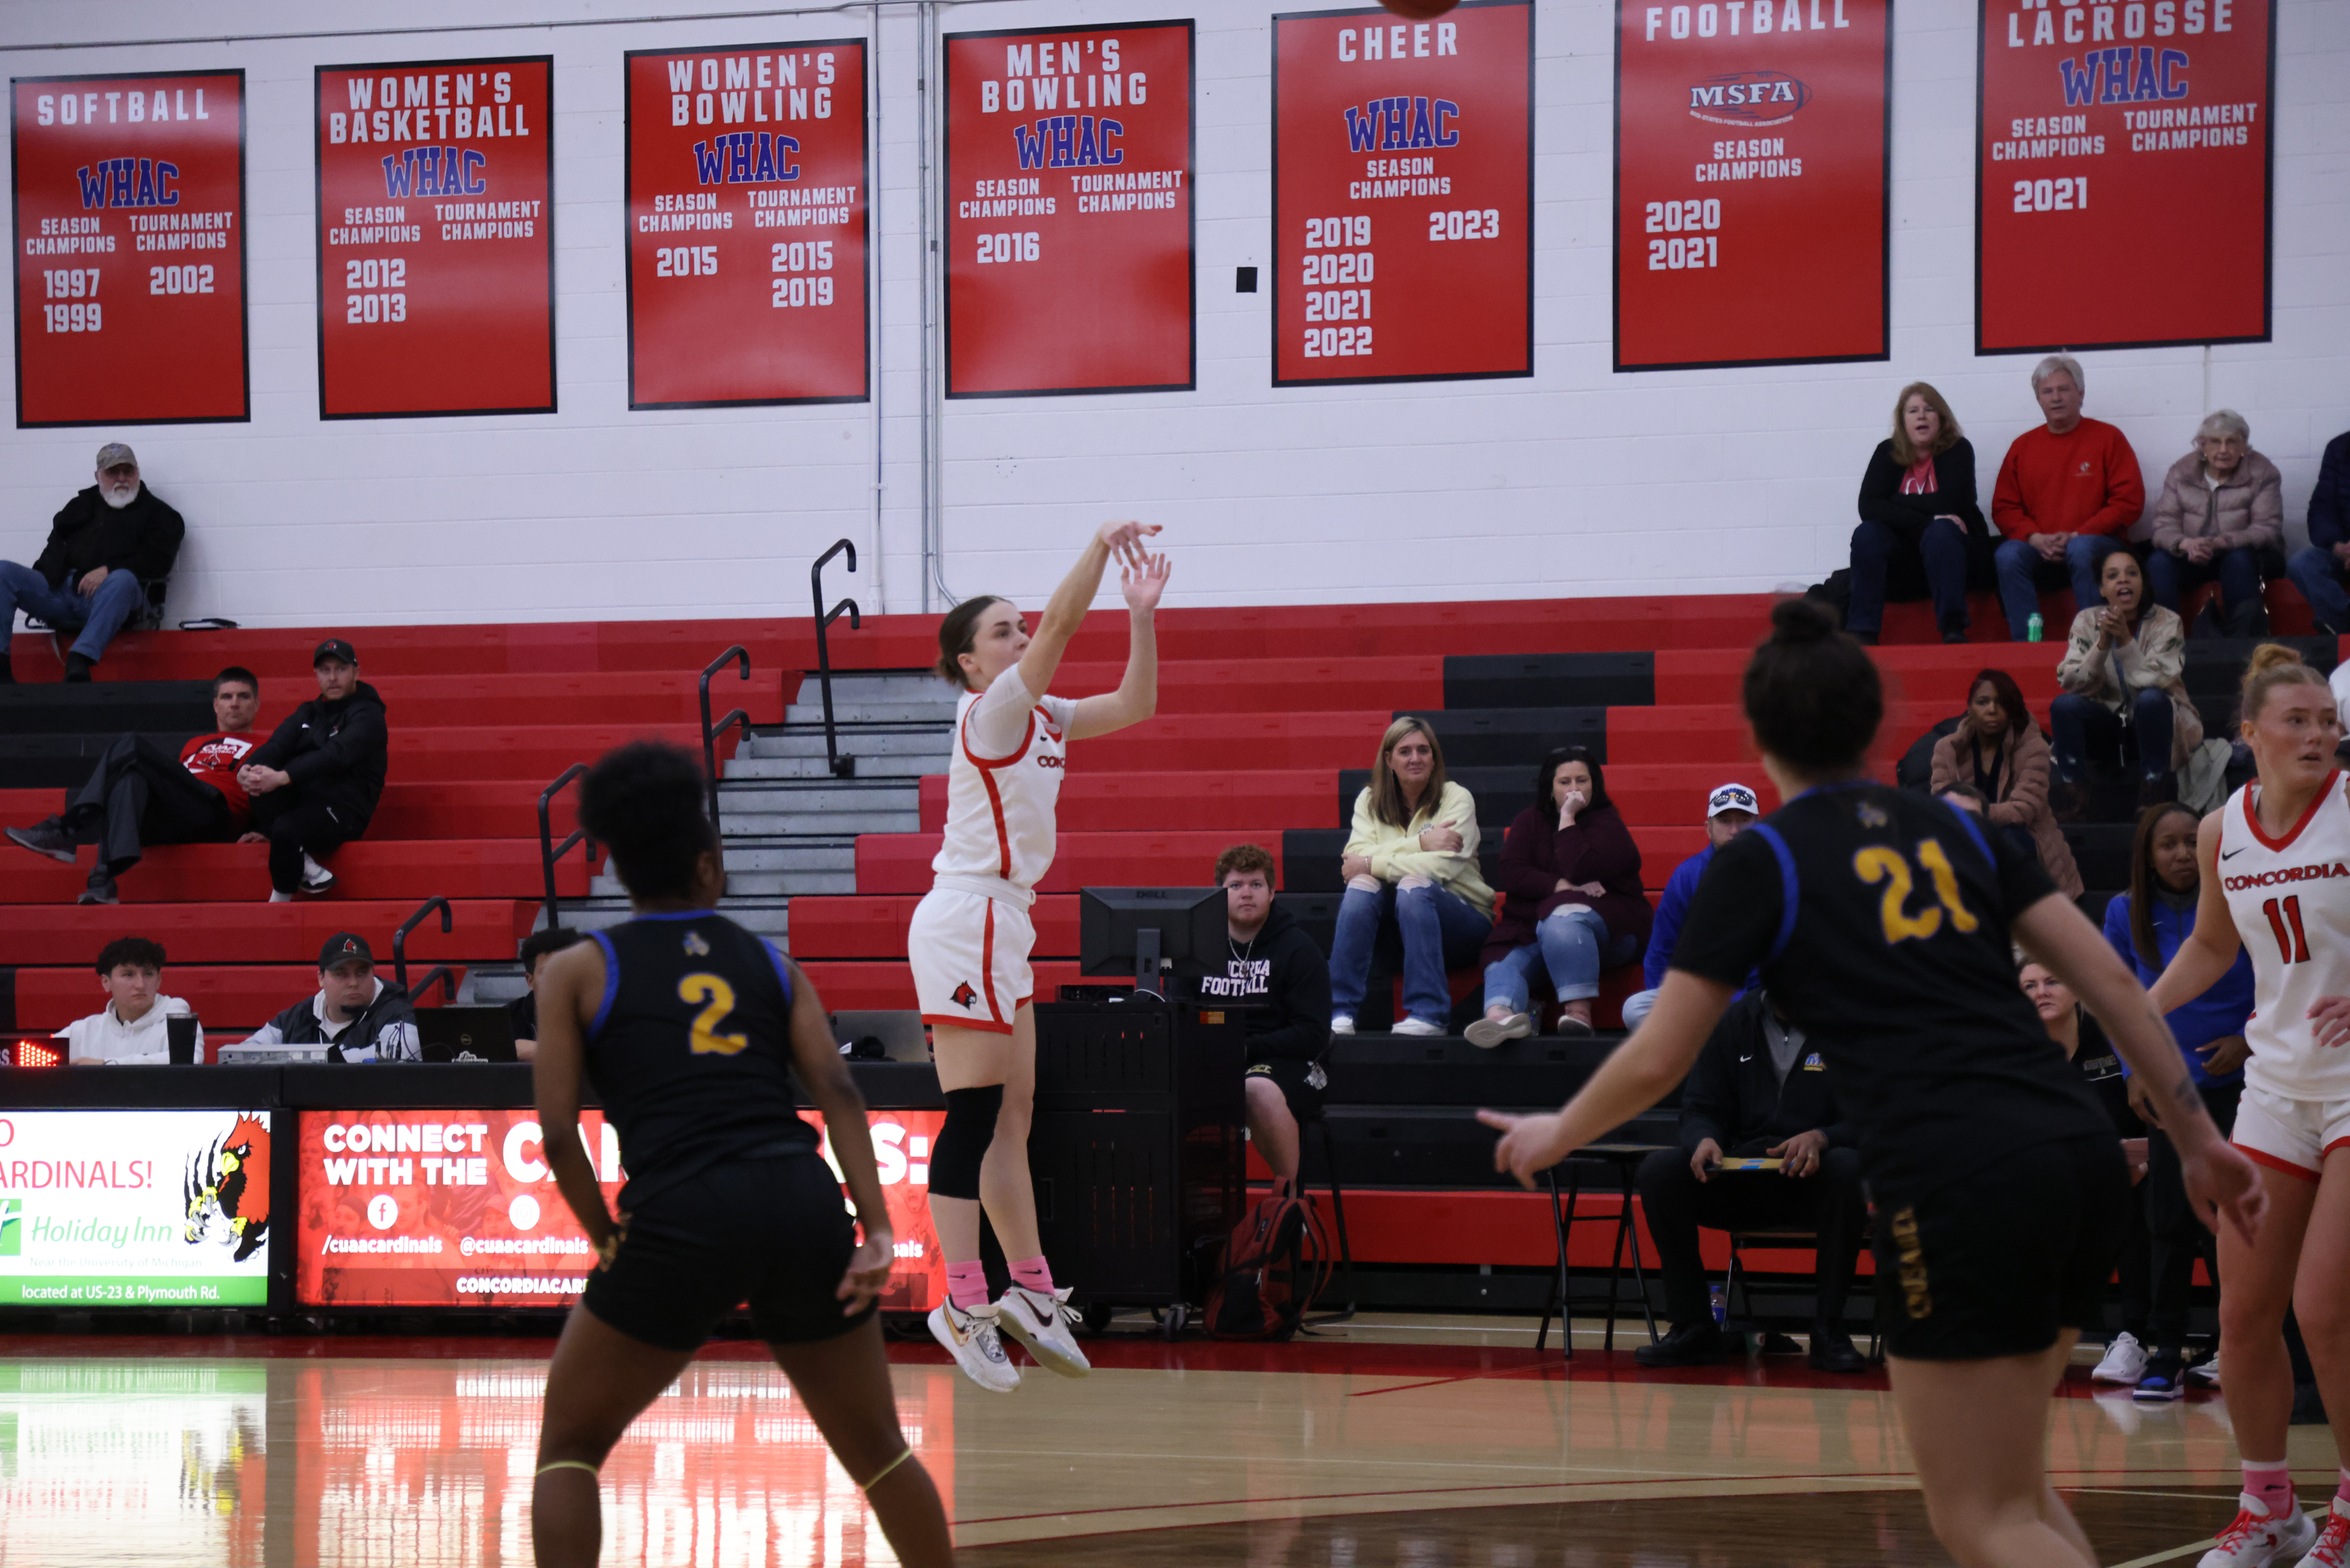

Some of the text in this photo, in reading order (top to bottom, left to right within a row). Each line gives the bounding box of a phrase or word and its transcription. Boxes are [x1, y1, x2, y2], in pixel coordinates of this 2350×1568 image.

[1646, 0, 1849, 41] FOOTBALL
[2008, 0, 2232, 48] LACROSSE
[1339, 23, 1457, 61] CHEER
[668, 53, 834, 92] WOMEN'S
[1007, 39, 1119, 77] MEN'S
[348, 72, 510, 110] WOMEN'S
[2059, 46, 2189, 107] WHAC
[673, 87, 831, 126] BOWLING
[982, 73, 1146, 112] BOWLING
[1689, 79, 1795, 110] MSFA
[38, 90, 209, 125] SOFTBALL
[2124, 103, 2256, 130] TOURNAMENT
[330, 105, 528, 143] BASKETBALL
[1344, 96, 1459, 152] WHAC
[2012, 115, 2086, 137] SEASON
[2132, 126, 2247, 151] CHAMPIONS
[1013, 115, 1124, 170] WHAC
[1714, 138, 1783, 159] SEASON
[1993, 136, 2104, 160] CHAMPIONS
[693, 131, 800, 185] WHAC
[1367, 157, 1433, 177] SEASON
[1696, 158, 1801, 181] CHAMPIONS
[77, 157, 179, 209] WHAC
[382, 146, 486, 200] WHAC
[976, 178, 1039, 197] SEASON
[1071, 171, 1182, 192] TOURNAMENT
[655, 193, 716, 212] SEASON
[748, 187, 855, 208] TOURNAMENT
[1079, 191, 1175, 212] CHAMPIONS
[1350, 177, 1450, 199] CHAMPIONS
[2014, 177, 2087, 212] 2021
[130, 212, 232, 232] TOURNAMENT
[345, 206, 404, 224] SEASON
[435, 201, 540, 221] TOURNAMENT
[639, 212, 732, 232] CHAMPIONS
[755, 207, 848, 227] CHAMPIONS
[960, 198, 1055, 218] CHAMPIONS
[1646, 199, 1720, 232] 2020
[41, 217, 99, 235] SEASON
[330, 225, 420, 244] CHAMPIONS
[443, 221, 533, 240] CHAMPIONS
[1306, 216, 1370, 248] 2019
[1430, 209, 1499, 241] 2023
[27, 236, 115, 255] CHAMPIONS
[137, 232, 226, 251] CHAMPIONS
[977, 232, 1039, 263] 2016
[1649, 237, 1717, 270] 2021
[657, 246, 717, 276] 2015
[772, 241, 832, 272] 2015
[1303, 253, 1373, 285] 2020
[44, 268, 100, 298] 1997
[150, 265, 214, 294] 2002
[347, 259, 405, 288] 2012
[773, 277, 833, 307] 2019
[1306, 290, 1370, 321] 2021
[44, 303, 101, 332] 1999
[347, 293, 405, 323] 2013
[1305, 326, 1372, 357] 2022
[1853, 838, 1980, 945] 21
[2225, 863, 2350, 892] CONCORDIA
[1136, 890, 1167, 899] DELL
[2263, 895, 2311, 964] 11
[678, 972, 749, 1055] 2
[323, 1124, 487, 1153] CONNECT
[323, 1158, 487, 1186] WITH THE
[31, 1216, 172, 1247] Holiday Inn
[322, 1236, 442, 1256] /cuaacardinals
[460, 1236, 588, 1256] @cuaacardinals
[30, 1257, 202, 1270] Near the University of Michigan
[22, 1285, 220, 1302] located at US-23 & Plymouth Rd.
